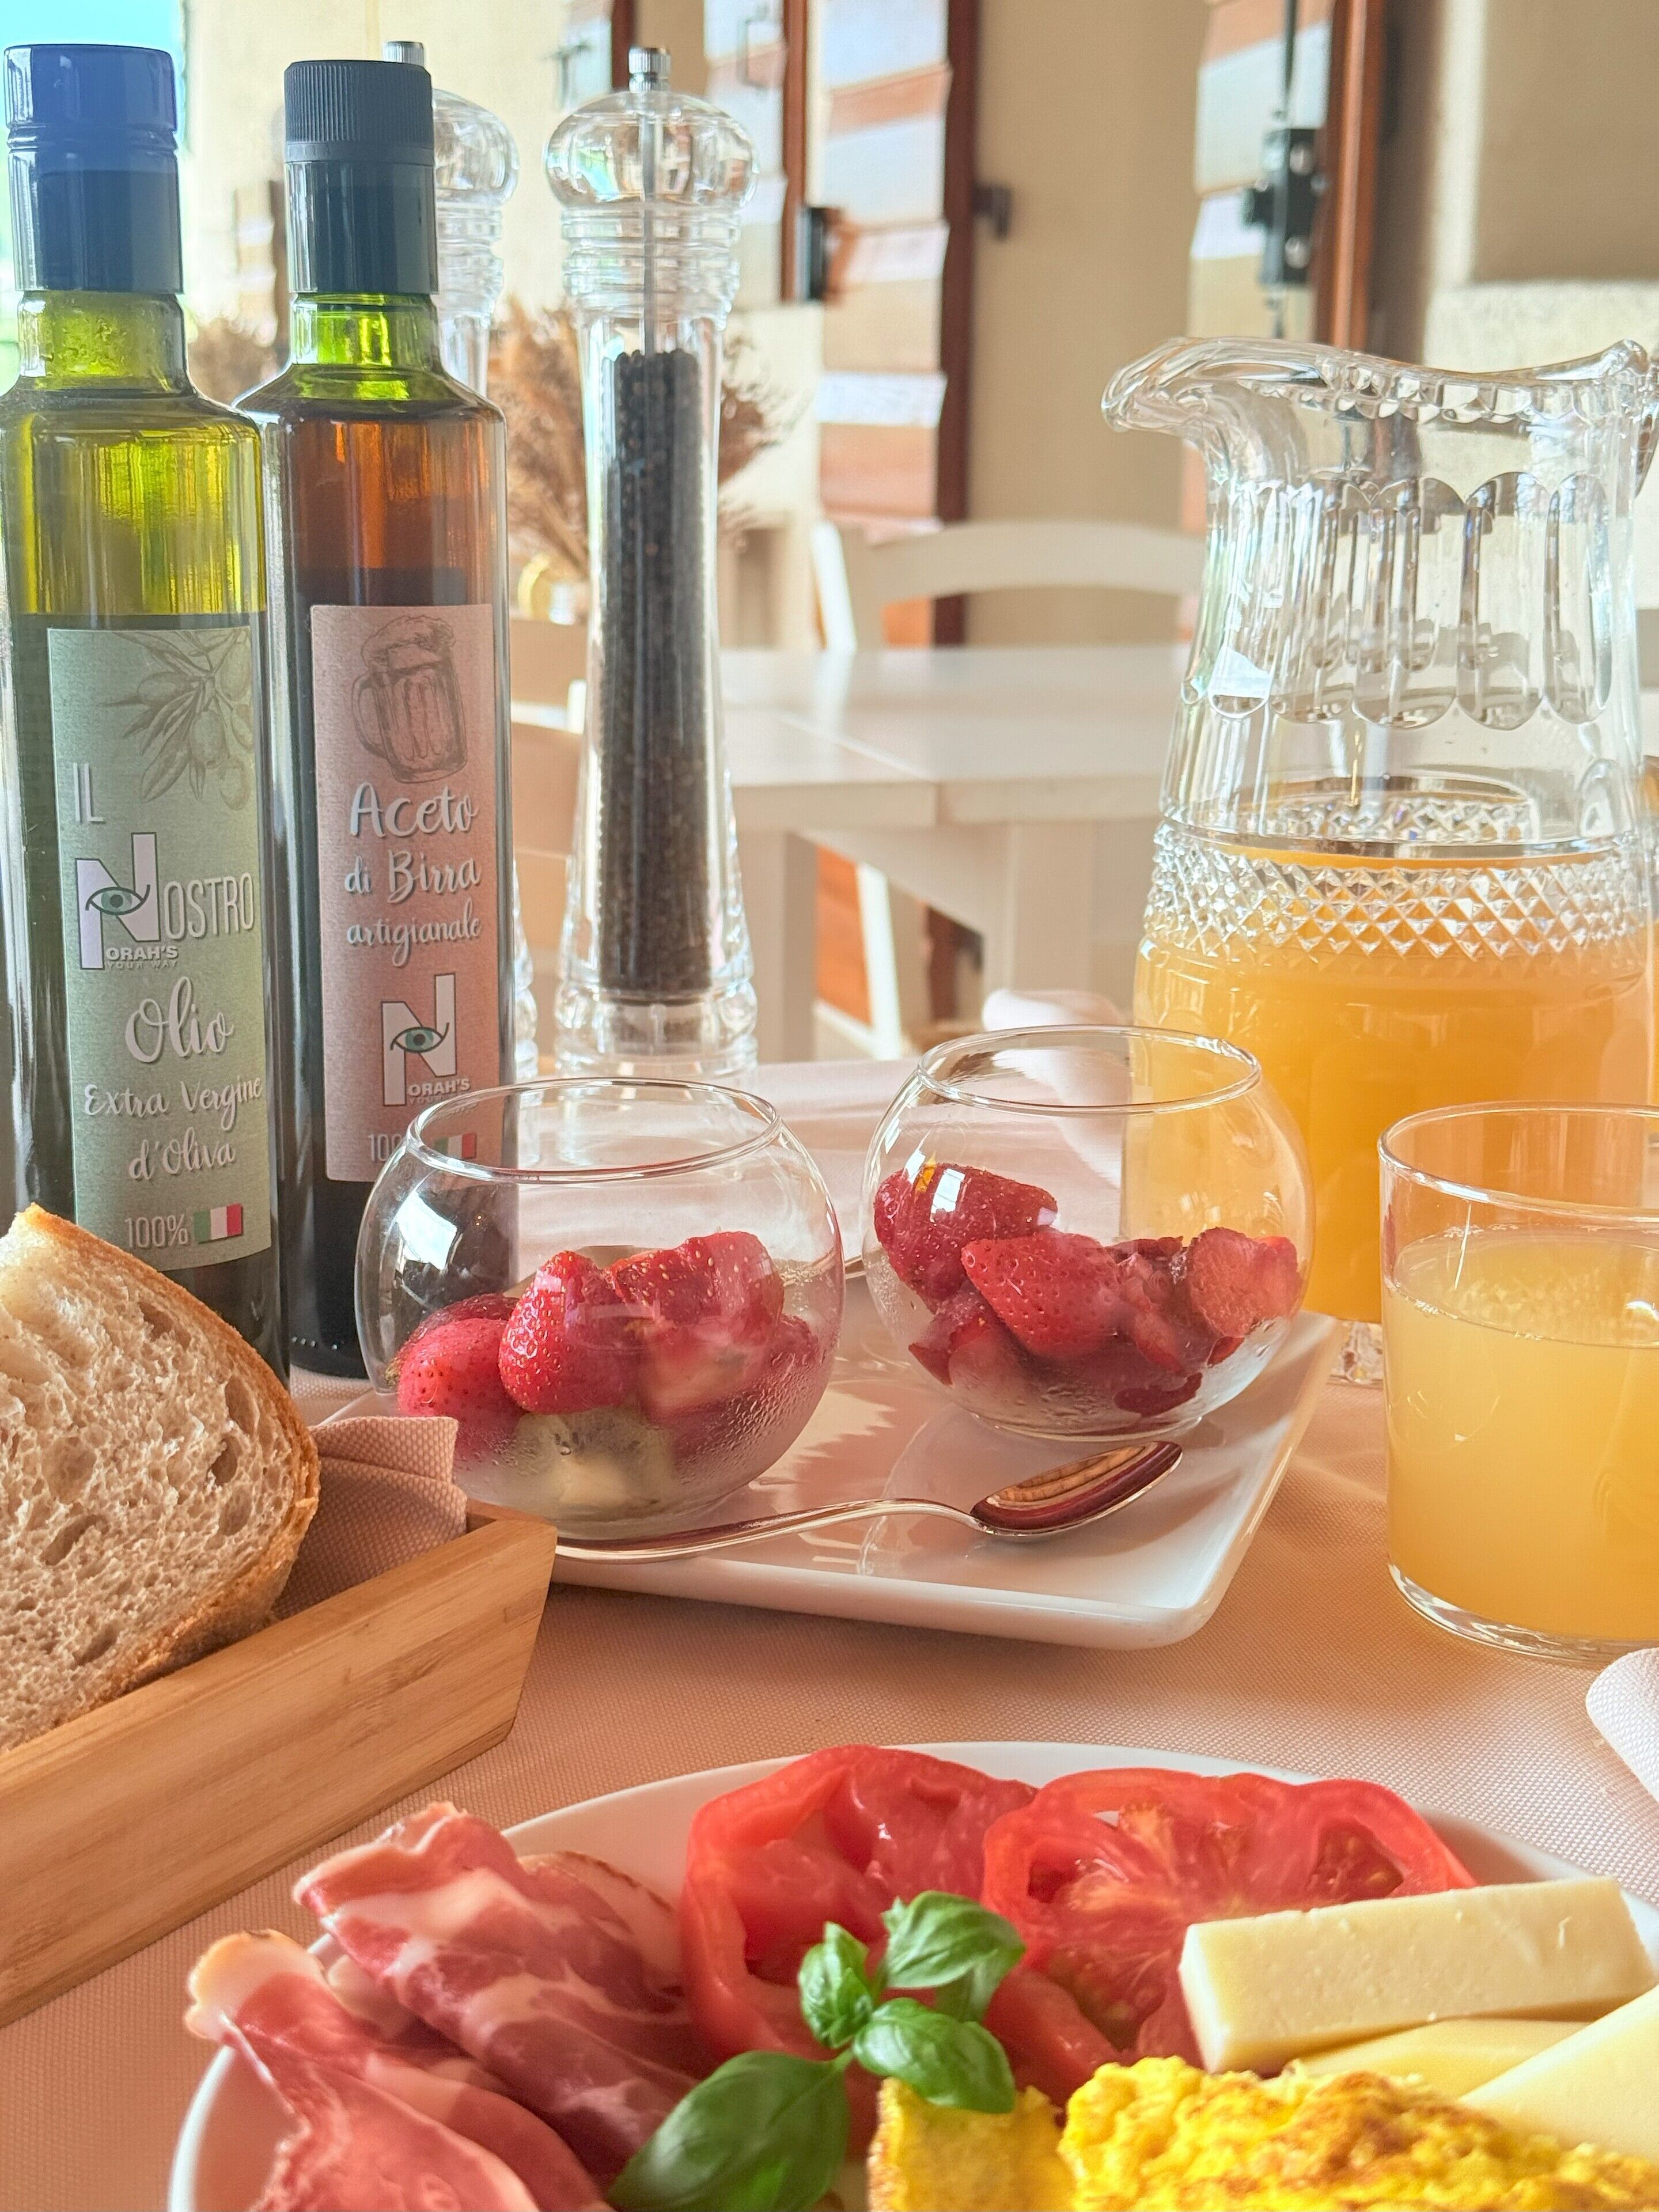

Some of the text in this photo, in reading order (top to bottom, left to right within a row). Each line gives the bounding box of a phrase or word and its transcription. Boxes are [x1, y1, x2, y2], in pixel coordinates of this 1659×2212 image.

[73, 762, 105, 823] IL
[350, 782, 478, 838] Aceto
[346, 849, 482, 904] di Birra
[346, 897, 482, 967] artigianale
[124, 976, 234, 1063] Olio
[84, 1077, 262, 1131] Extra Vergine
[124, 1214, 189, 1249] 100%
